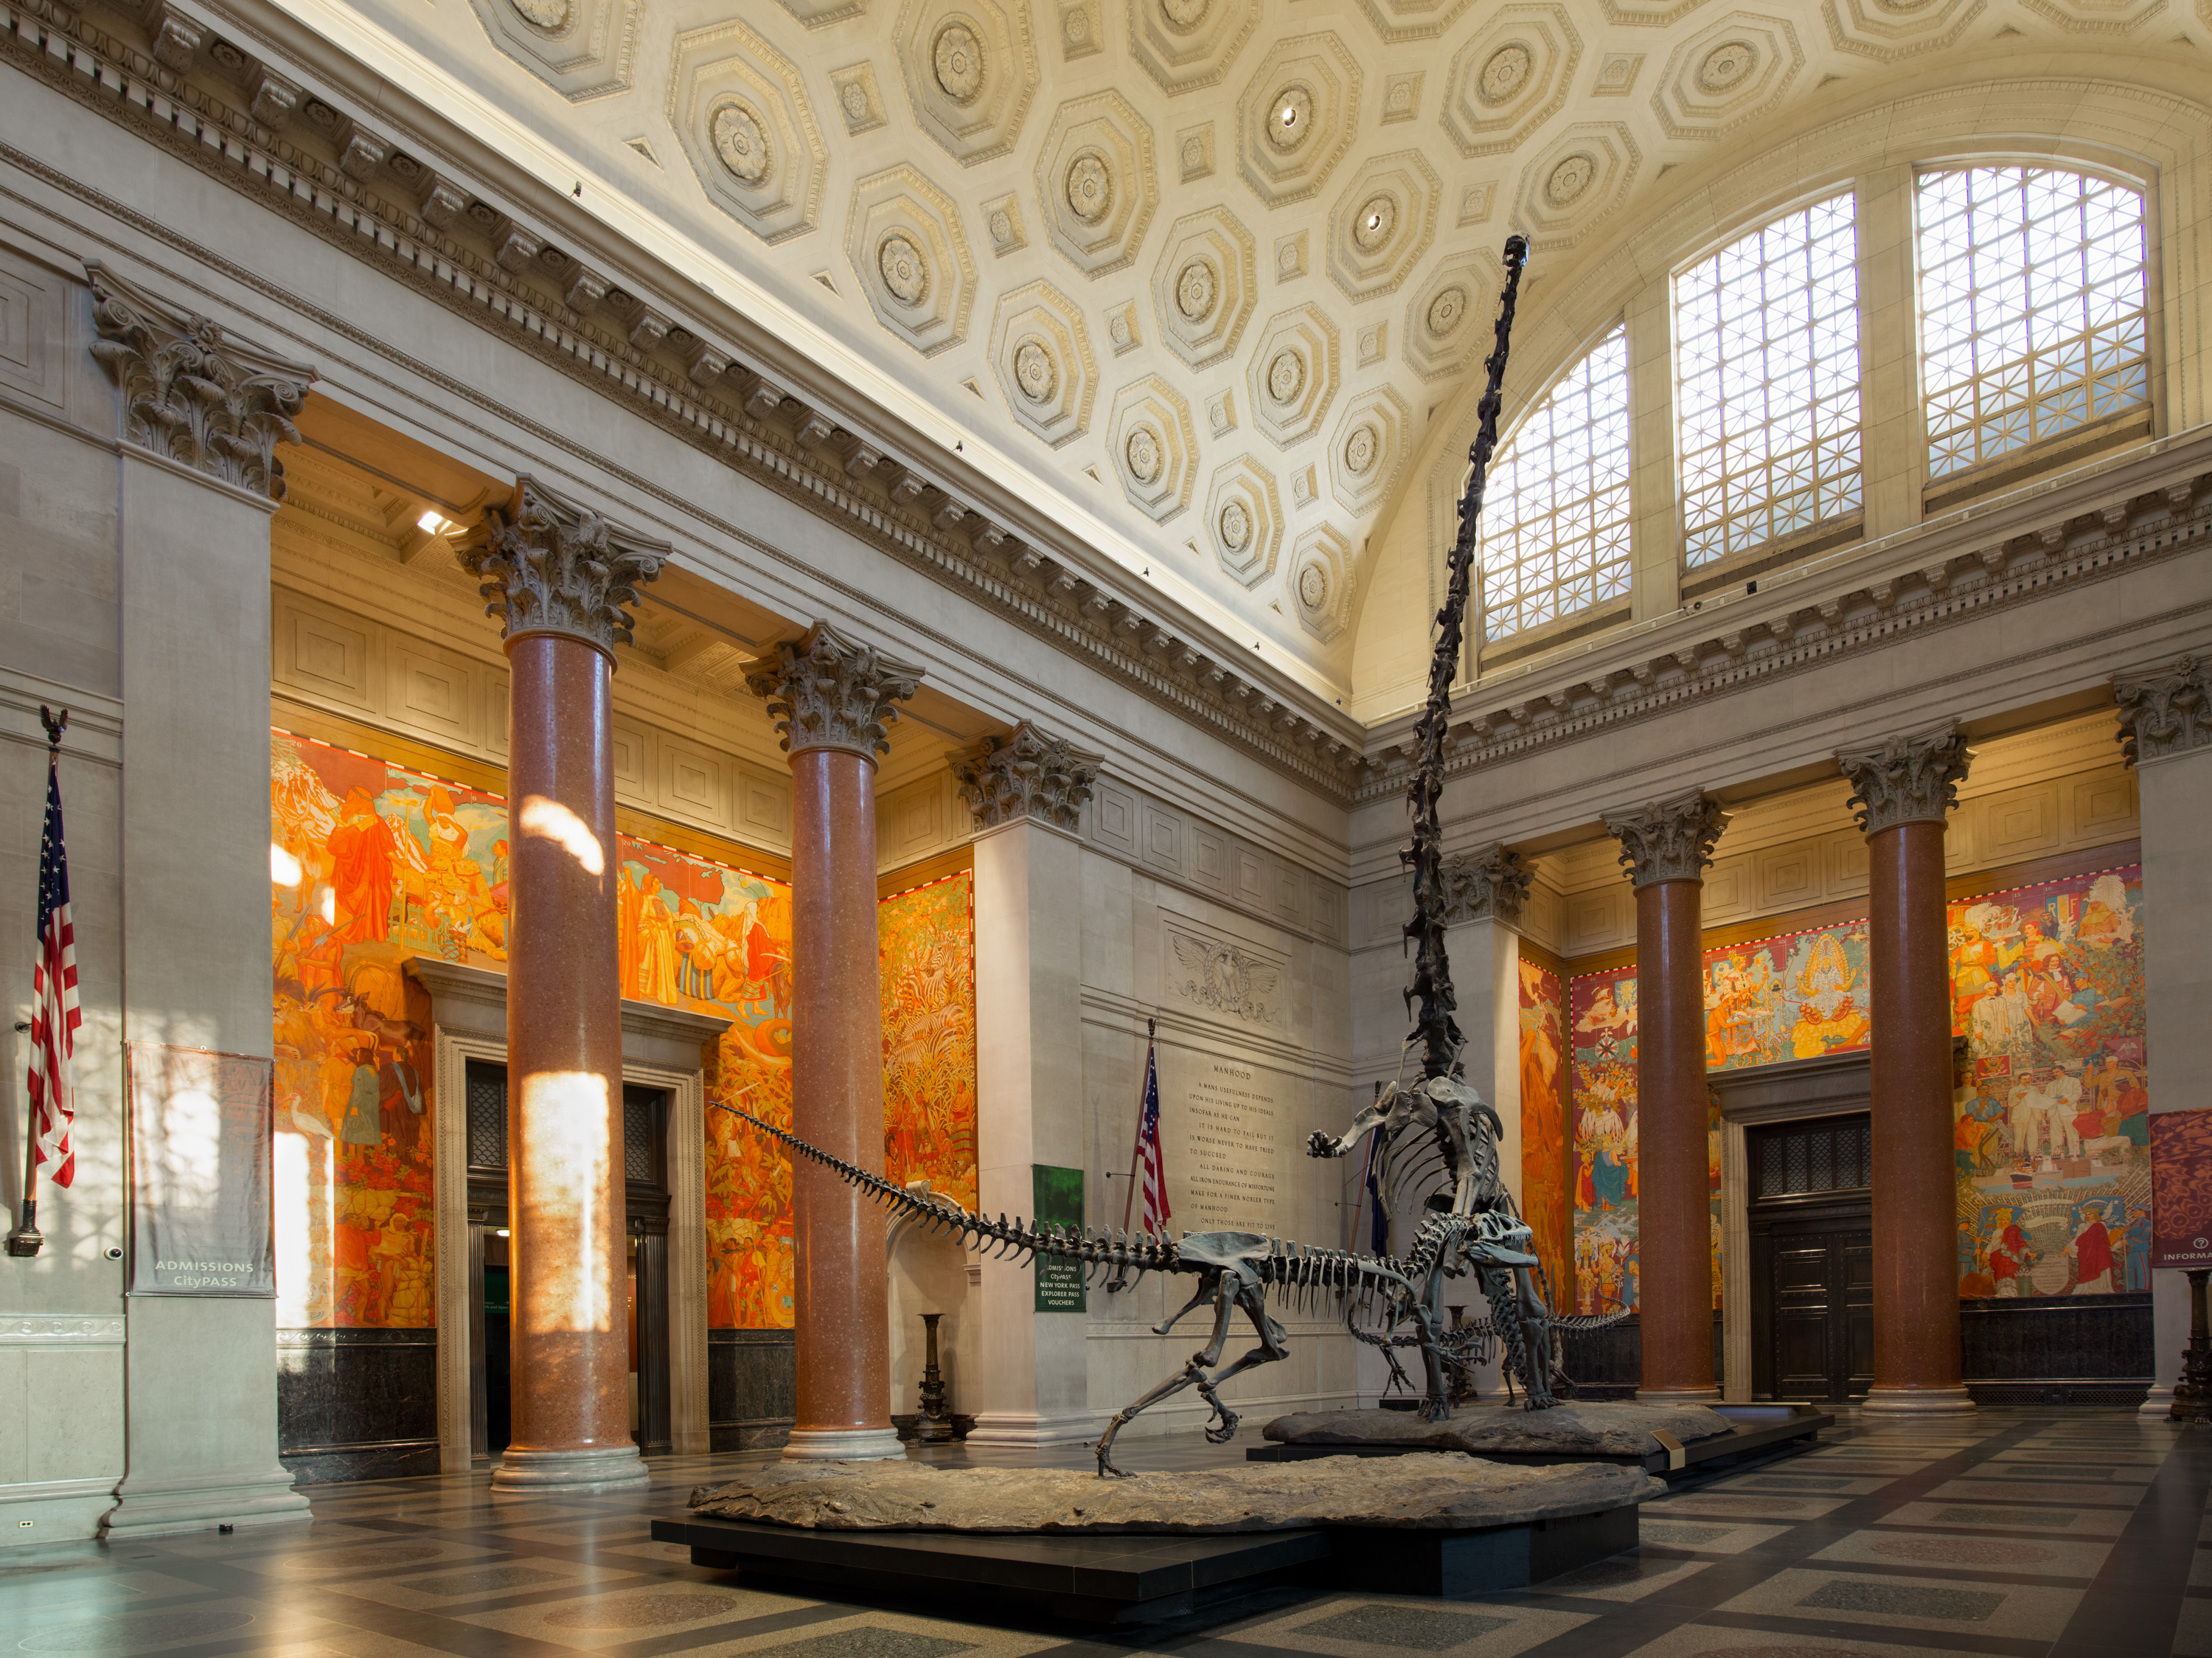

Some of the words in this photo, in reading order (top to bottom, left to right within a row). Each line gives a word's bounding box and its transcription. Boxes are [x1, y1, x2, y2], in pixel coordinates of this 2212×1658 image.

[1214, 1065, 1251, 1080] MANHOOD
[1220, 1087, 1250, 1098] USEFULNESS
[1252, 1094, 1273, 1103] DEPENDS
[1189, 1107, 1211, 1116] INSOFAR
[1197, 1136, 1215, 1144] WORSE
[1200, 1150, 1226, 1159] SUCCEED
[1213, 1179, 1240, 1187] ENDURANCE
[1248, 1184, 1274, 1192] MISFORTUNE
[155, 1261, 254, 1273] ADMISSIONS
[174, 1276, 237, 1288] CityPASS
